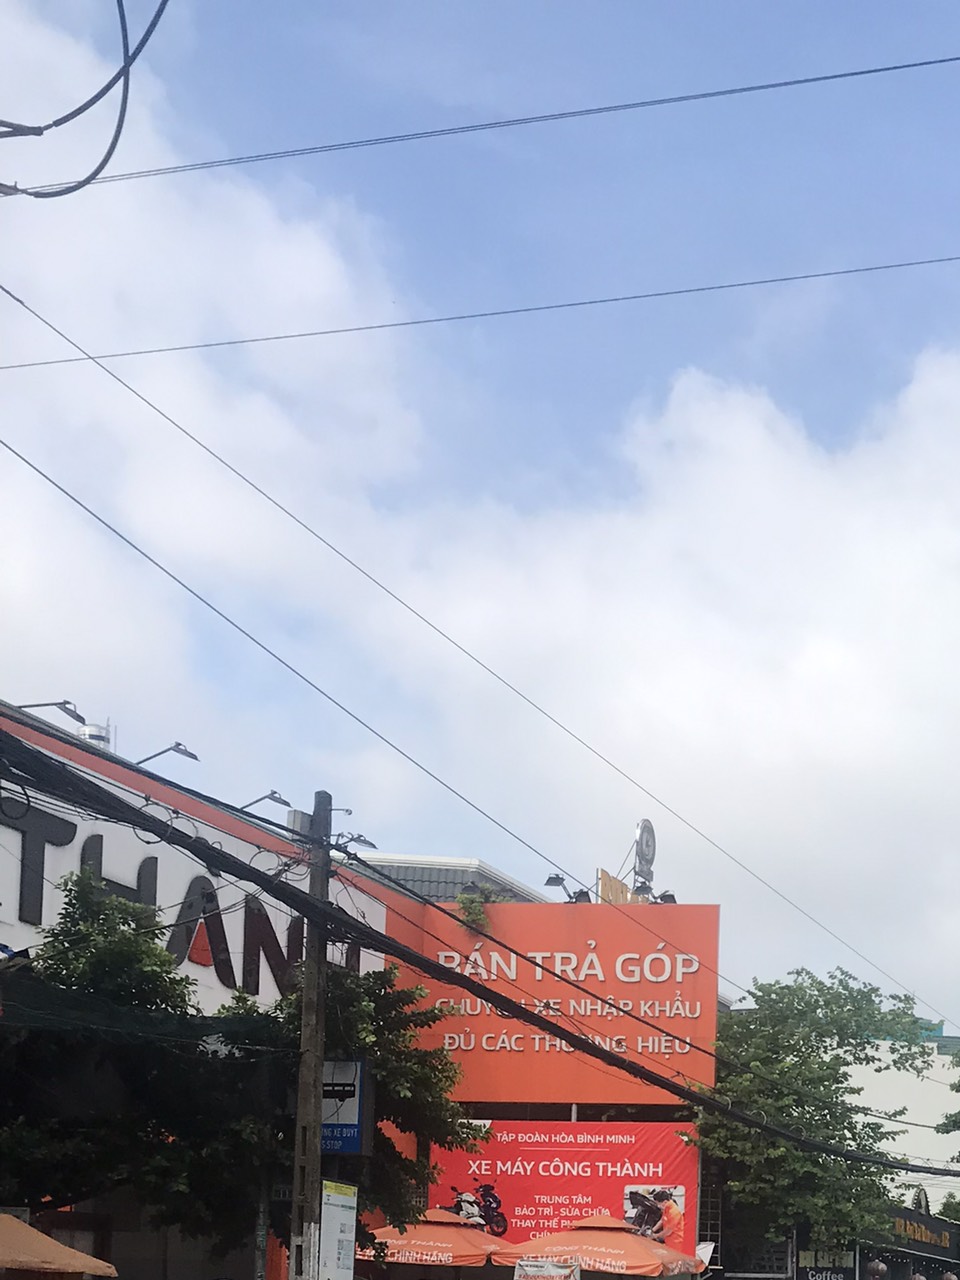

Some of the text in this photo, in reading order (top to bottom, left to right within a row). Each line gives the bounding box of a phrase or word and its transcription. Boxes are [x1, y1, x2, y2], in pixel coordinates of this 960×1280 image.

[437, 939, 700, 983] BÁN TRẢ GÓP
[533, 999, 562, 1016] XE
[569, 995, 633, 1020] NHẬP
[640, 990, 702, 1018] KHẨU
[443, 1027, 475, 1051] ĐỦ
[481, 1029, 524, 1051] CÁC
[637, 1033, 691, 1059] HIỆU
[496, 1131, 636, 1144] TẬP ĐOÀN HÒA BÌNH MINH
[467, 1157, 663, 1177] XE MÁY CÔNG THÀNH
[534, 1193, 592, 1205] TRUNG TÂM
[514, 1206, 535, 1216] BẢO
[537, 1206, 553, 1216] TRÌ
[560, 1206, 580, 1216] SỬA
[582, 1206, 611, 1217] CHỮA
[511, 1219, 536, 1228] THAY
[539, 1217, 560, 1229] THẾ
[808, 1270, 844, 1280] Coffee
